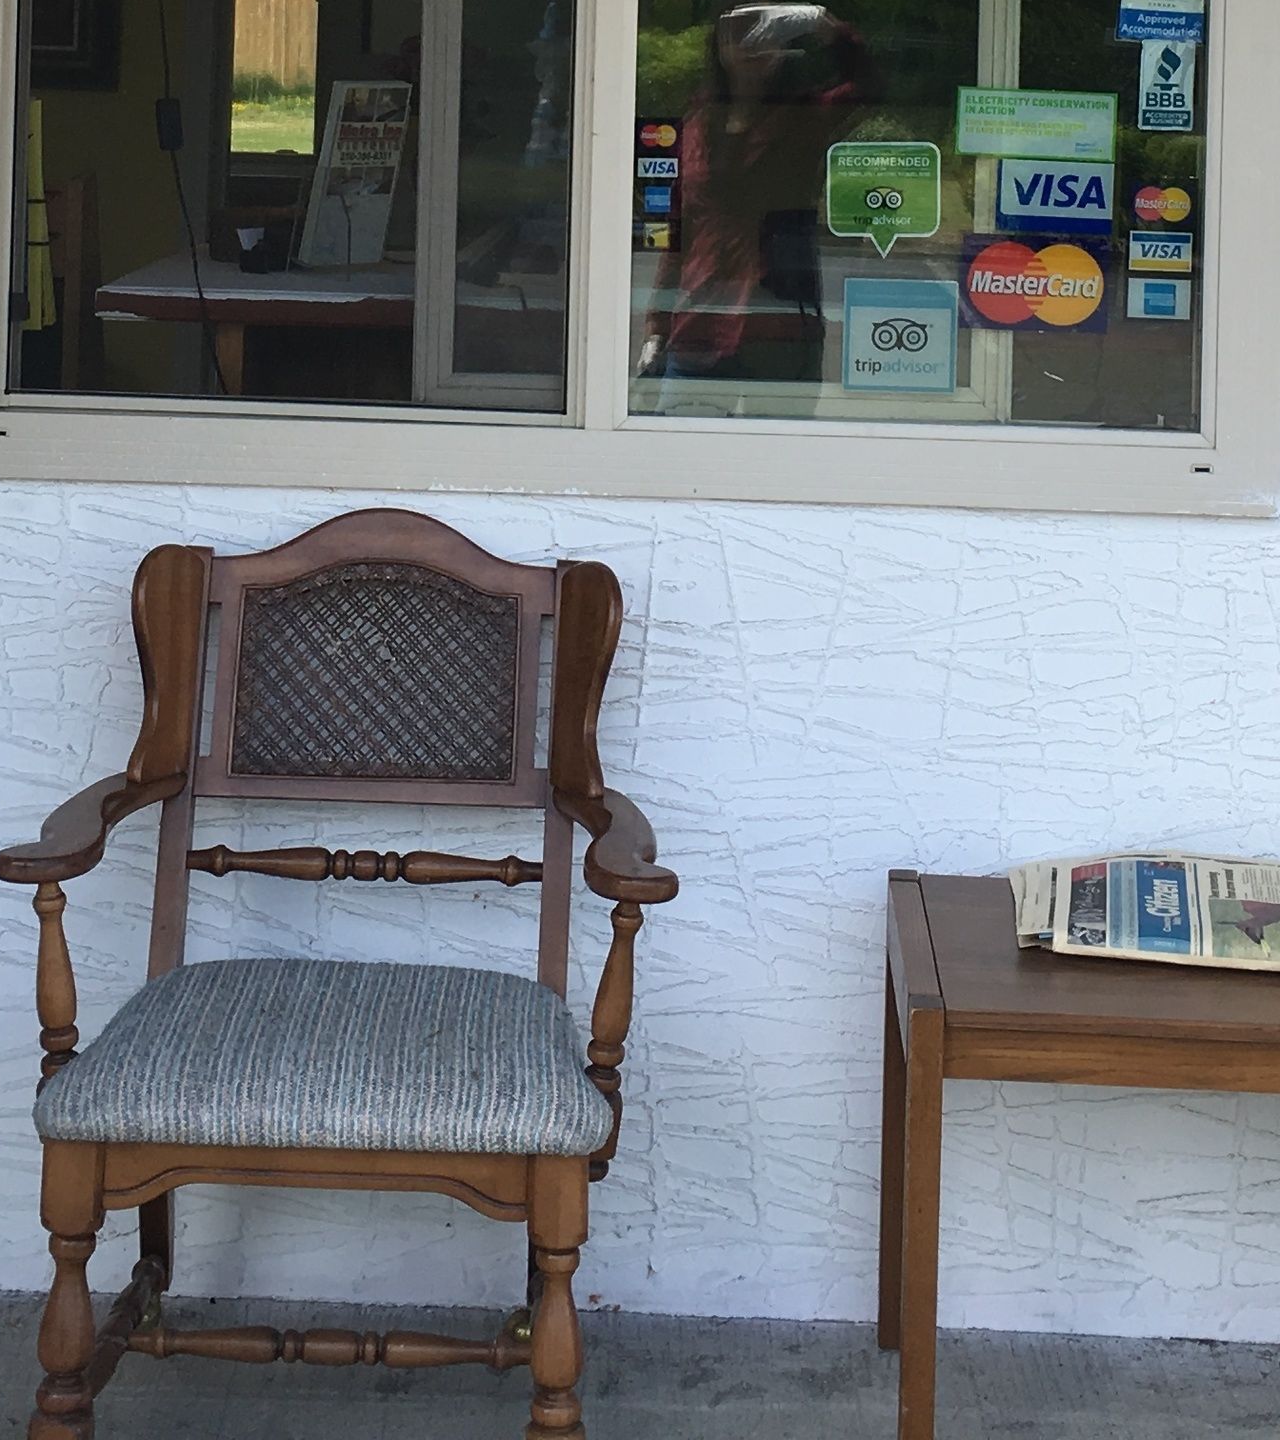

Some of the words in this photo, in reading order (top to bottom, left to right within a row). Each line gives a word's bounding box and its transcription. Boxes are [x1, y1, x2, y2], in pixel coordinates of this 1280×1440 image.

[1137, 13, 1186, 25] Approved
[1120, 23, 1201, 37] Accommodation
[965, 95, 1030, 107] ELECTRICITY
[1032, 98, 1109, 110] CONSERVATION
[1145, 92, 1186, 108] BBB
[965, 106, 977, 114] IN
[978, 106, 1016, 116] ACTION
[642, 161, 676, 174] VISA
[838, 156, 930, 167] RECOMMENDED
[1014, 173, 1107, 210] VISA
[1134, 198, 1190, 210] MasterCard
[853, 215, 912, 226] tripadvisor
[1140, 243, 1182, 260] VISA
[970, 270, 1100, 298] MasterCard
[855, 358, 939, 376] tripadvisor
[1145, 878, 1181, 918] Citizen
